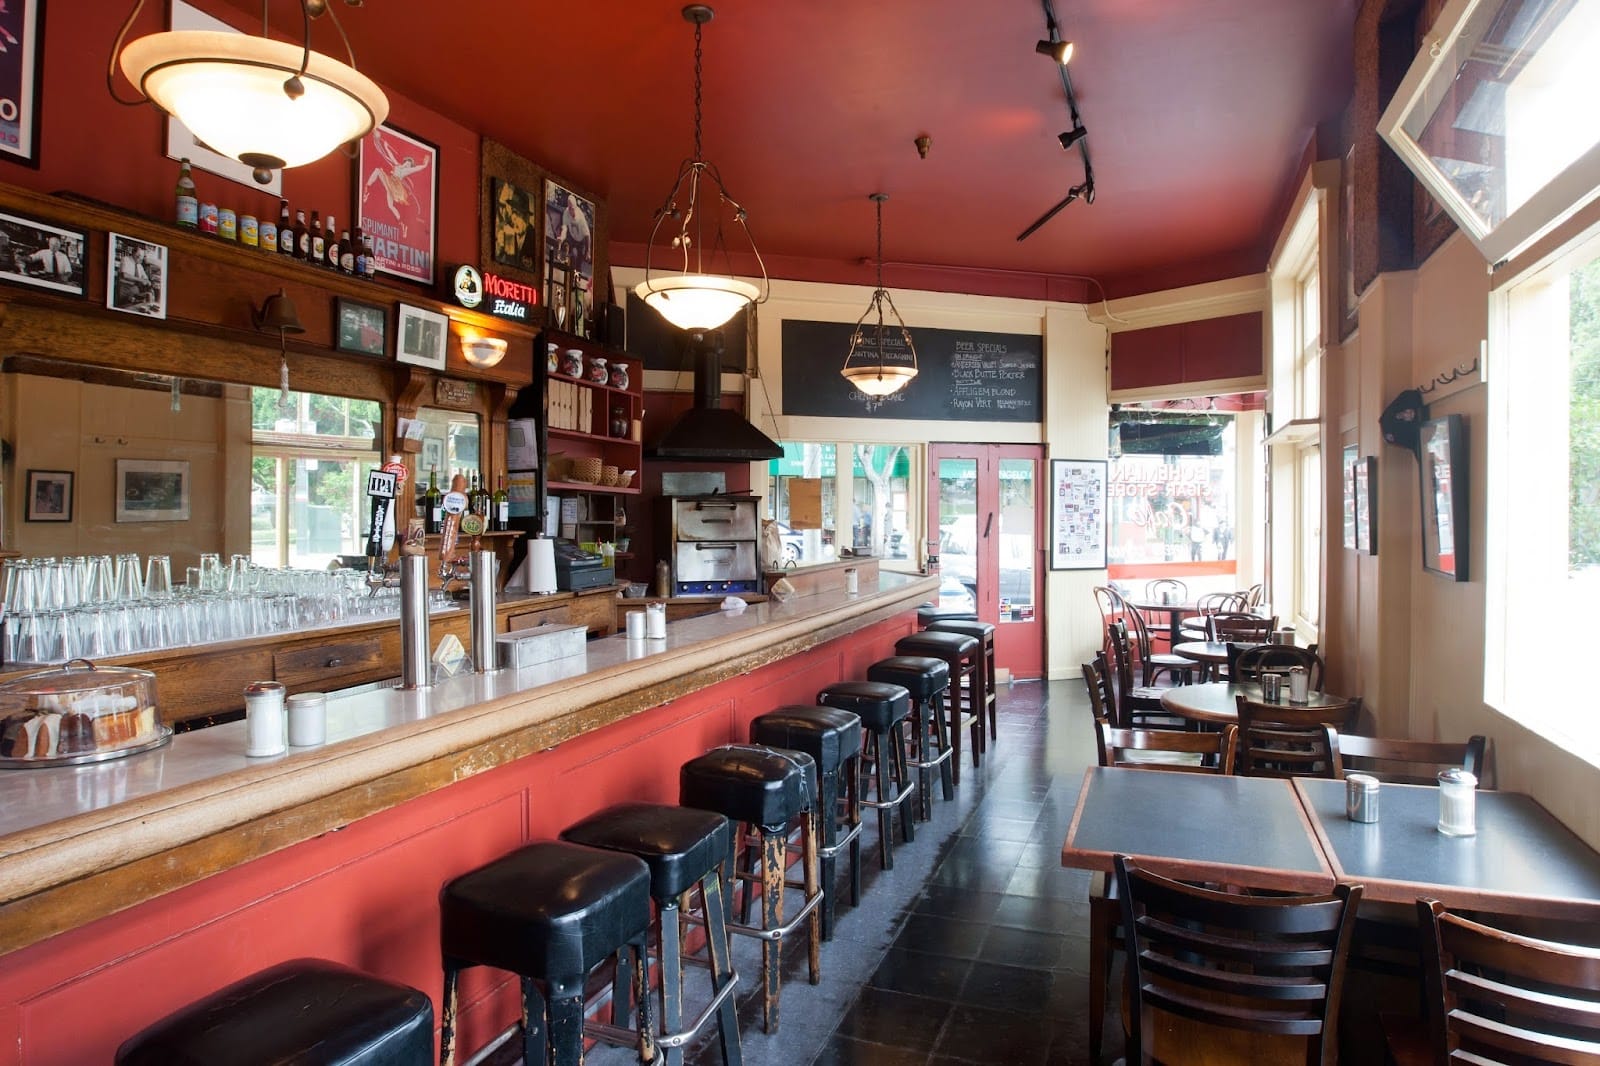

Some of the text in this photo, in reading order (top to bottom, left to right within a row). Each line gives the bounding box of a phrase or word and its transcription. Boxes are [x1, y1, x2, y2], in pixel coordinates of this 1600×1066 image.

[362, 216, 400, 241] SPUMANTI
[484, 272, 538, 305] MORETTI
[493, 299, 526, 318] Italia
[977, 343, 1008, 353] SPECIALS
[953, 369, 1025, 380] BLACK BUTTE PORTER
[991, 388, 1017, 397] BLOND
[371, 478, 392, 493] IPA
